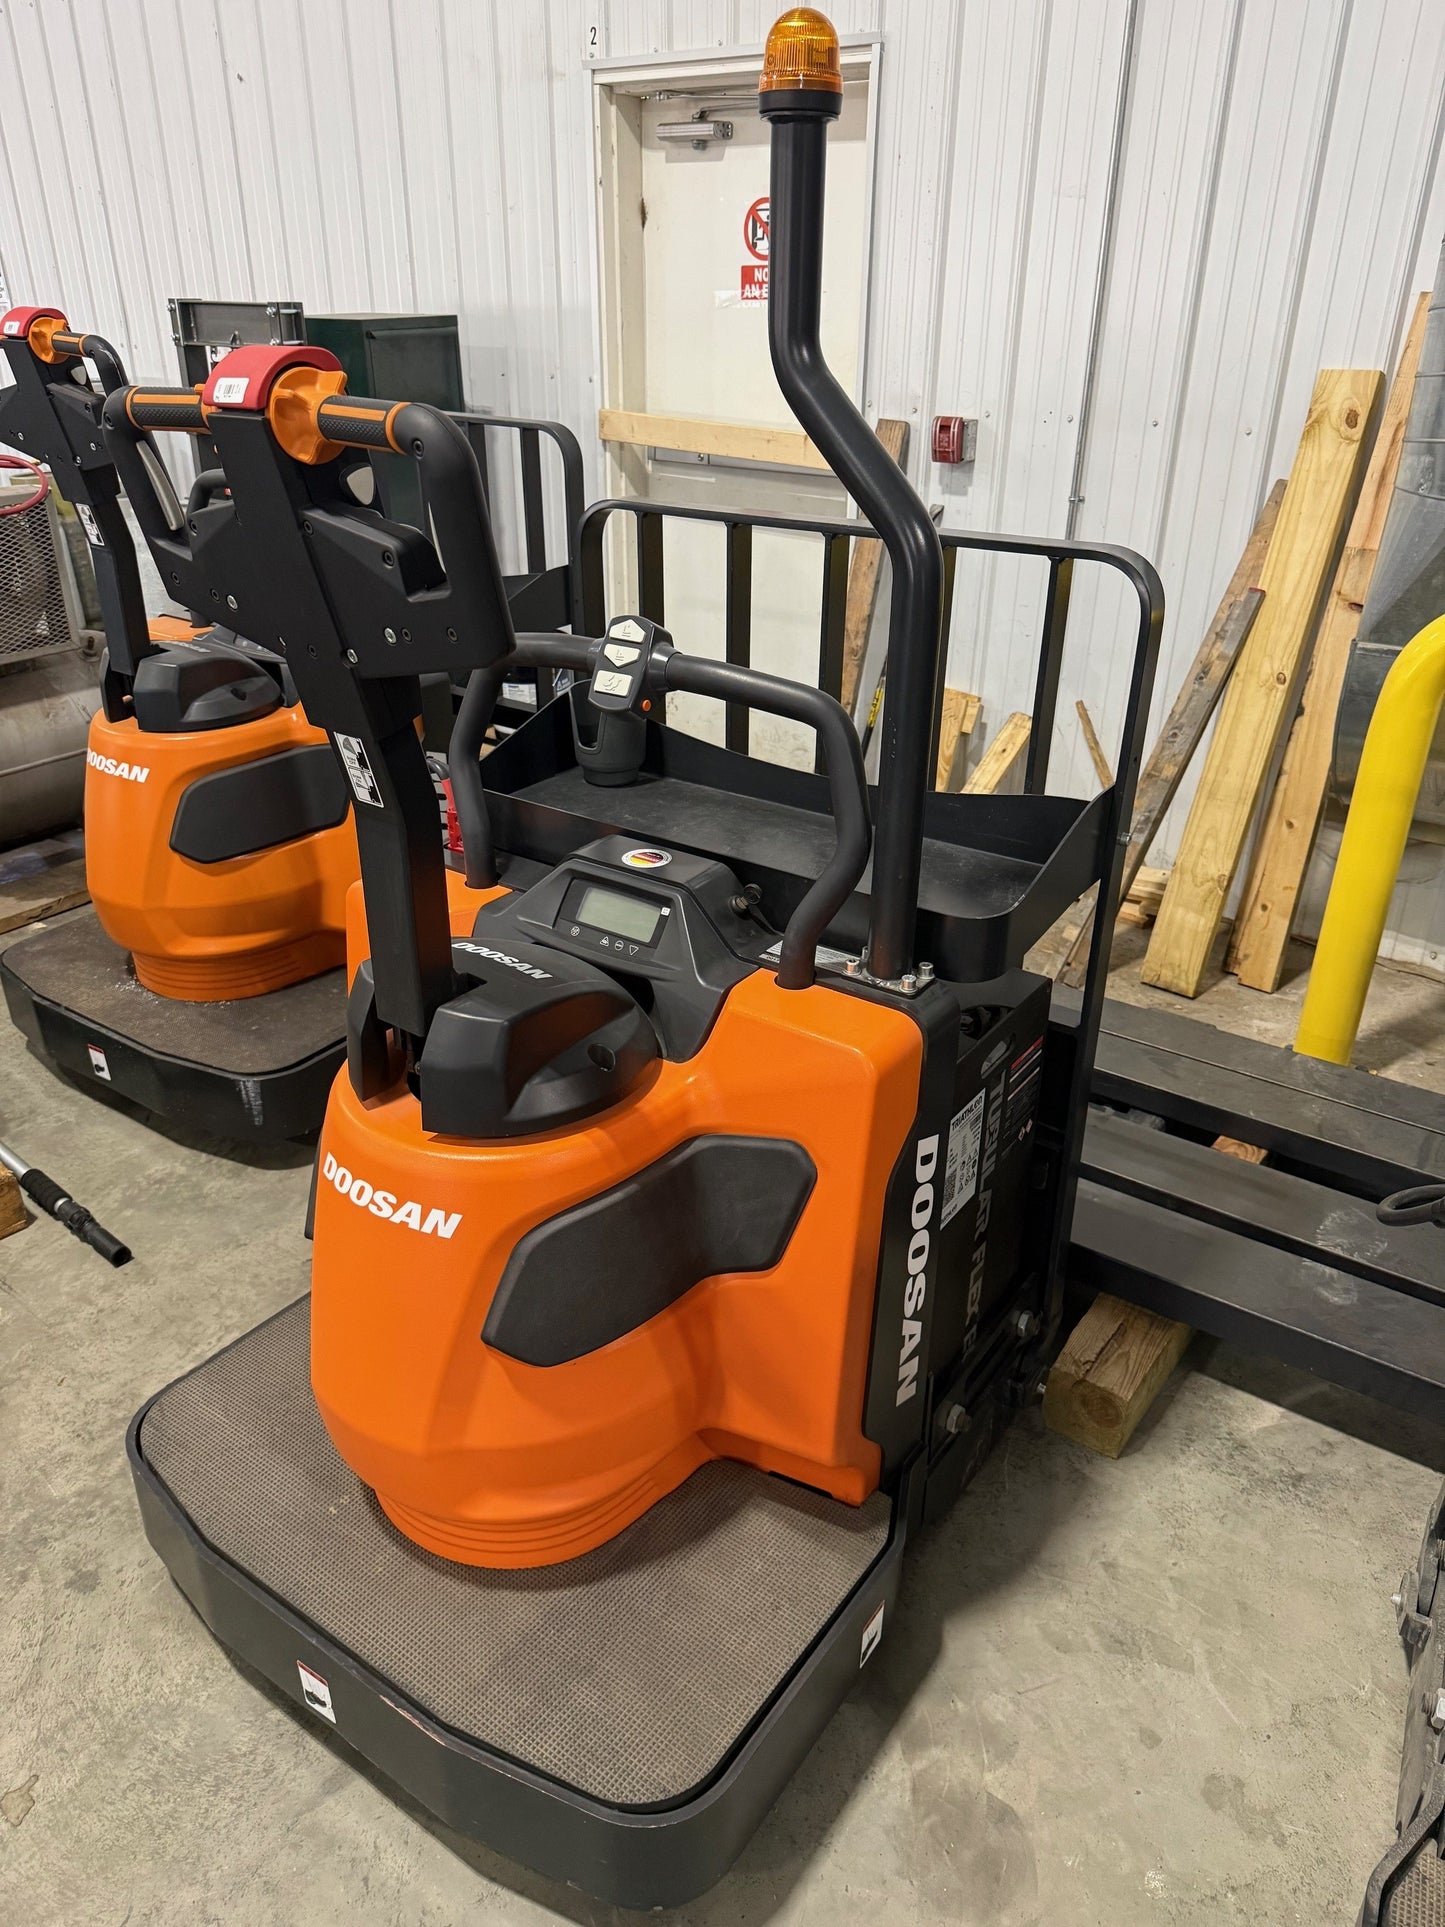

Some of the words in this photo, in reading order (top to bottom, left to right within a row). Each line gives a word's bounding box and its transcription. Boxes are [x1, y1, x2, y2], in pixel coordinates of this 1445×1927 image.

[590, 26, 597, 46] 2
[451, 942, 553, 979] DOOSAN
[323, 1151, 463, 1239] DOOSAN
[895, 1134, 939, 1407] DOOSAN
